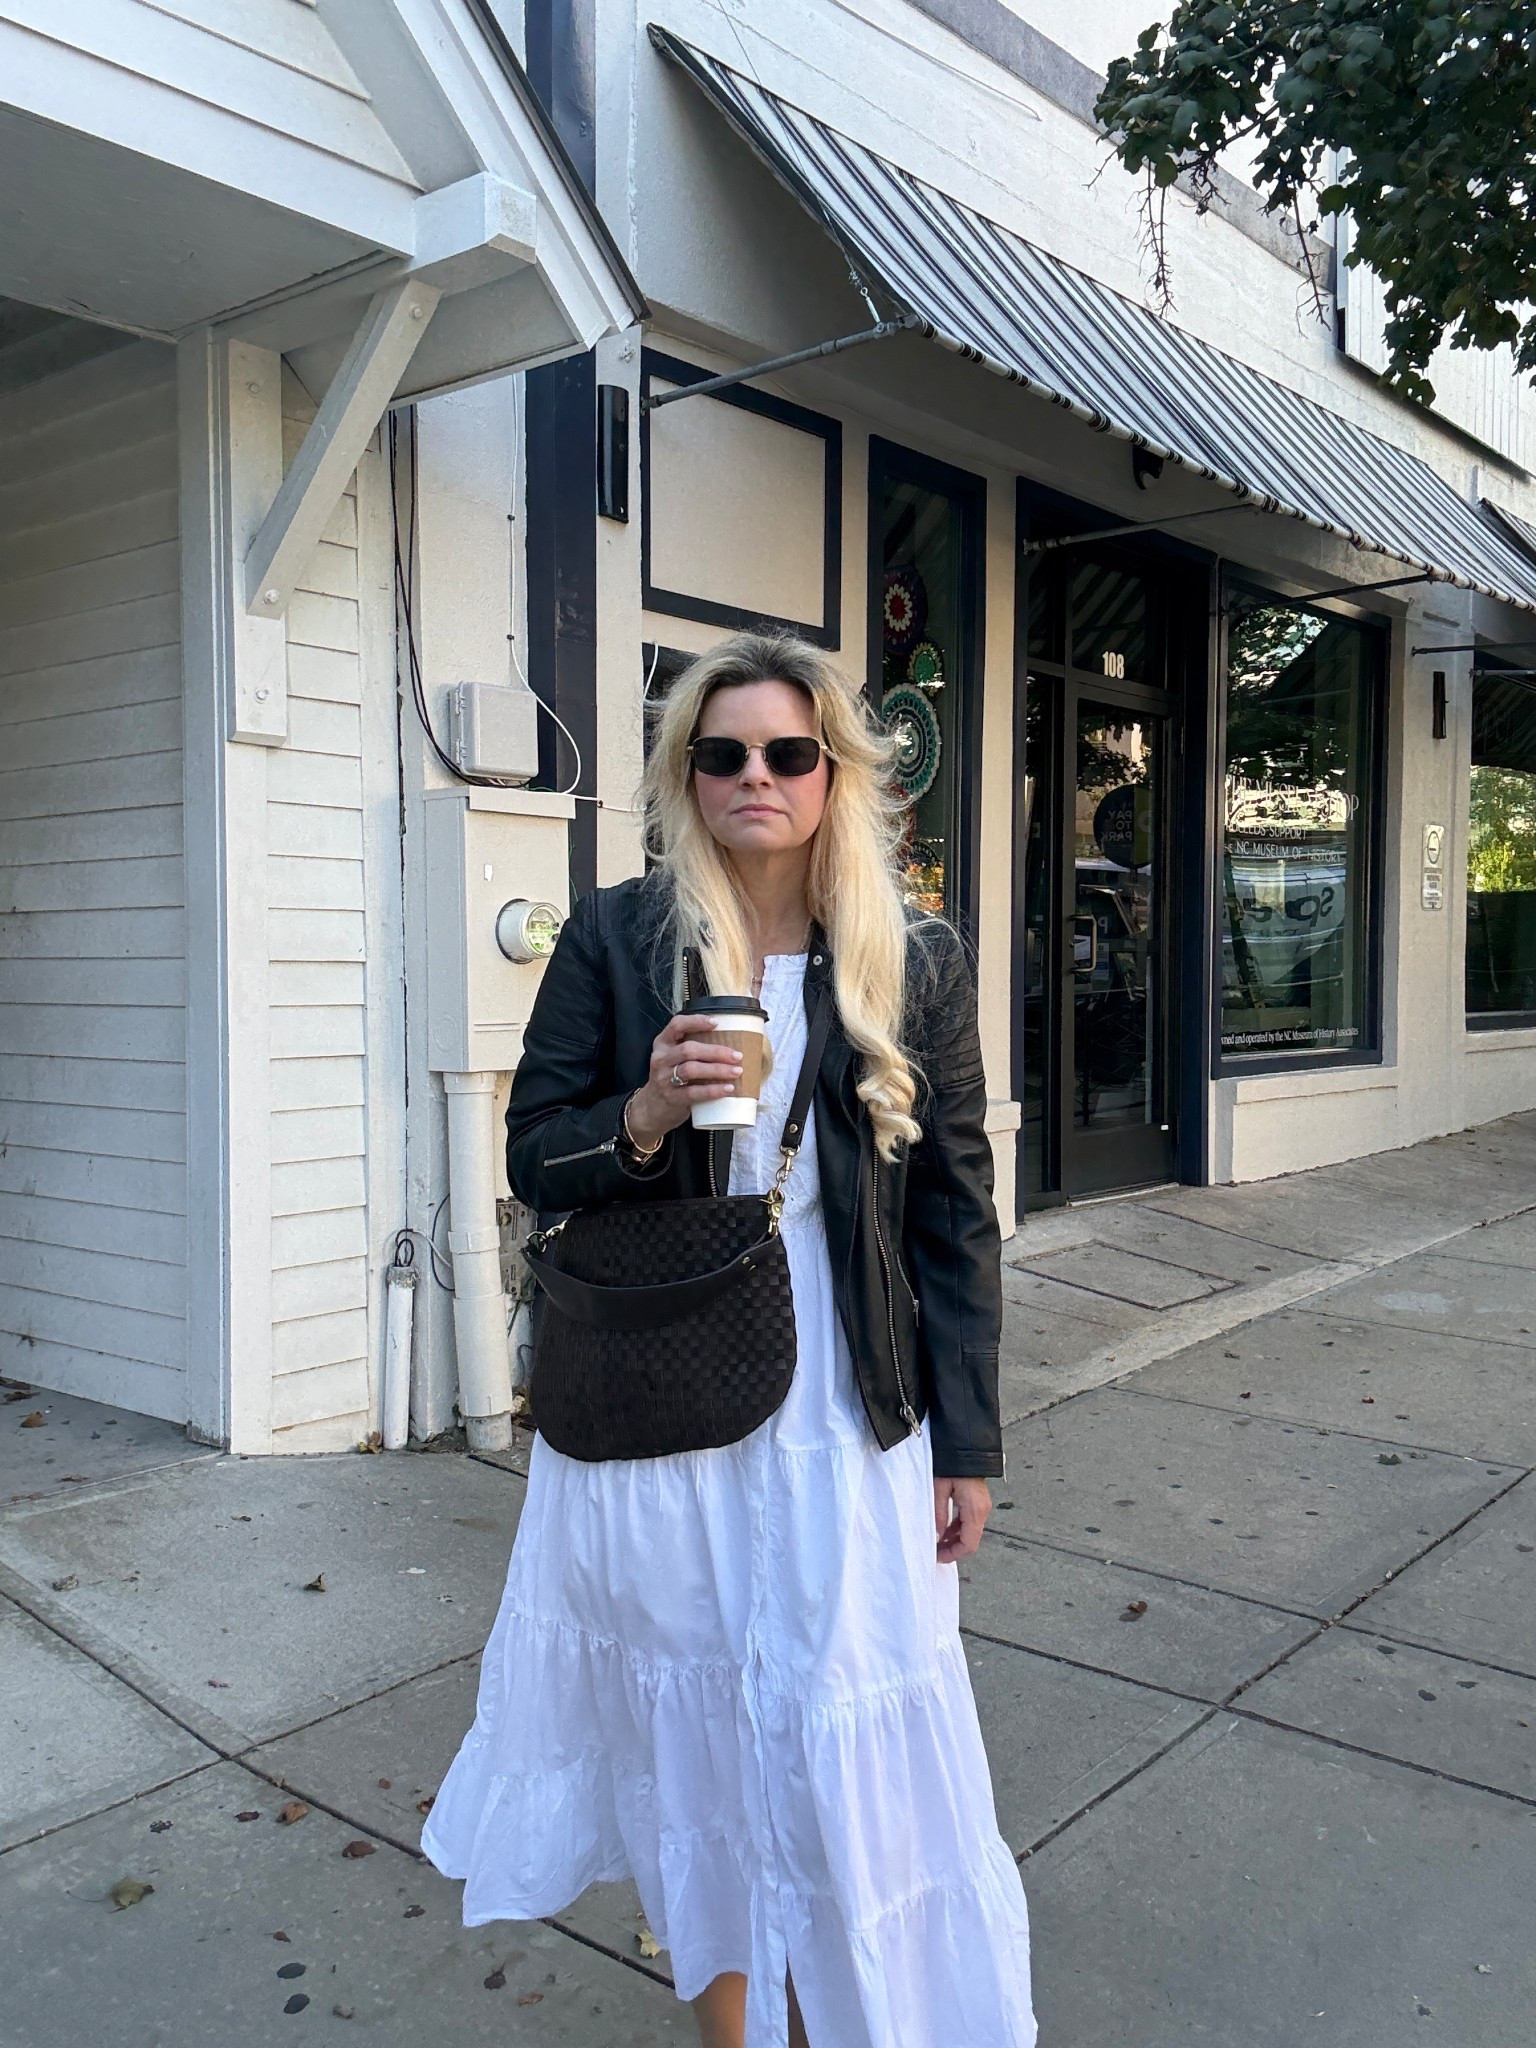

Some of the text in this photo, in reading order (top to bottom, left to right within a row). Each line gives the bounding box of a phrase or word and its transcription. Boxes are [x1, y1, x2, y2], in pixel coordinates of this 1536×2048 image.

[1102, 651, 1125, 680] 108
[1269, 826, 1306, 840] SUPPORT
[1236, 840, 1250, 855] NC
[1253, 843, 1289, 858] MUSEUM
[1292, 846, 1304, 860] OF
